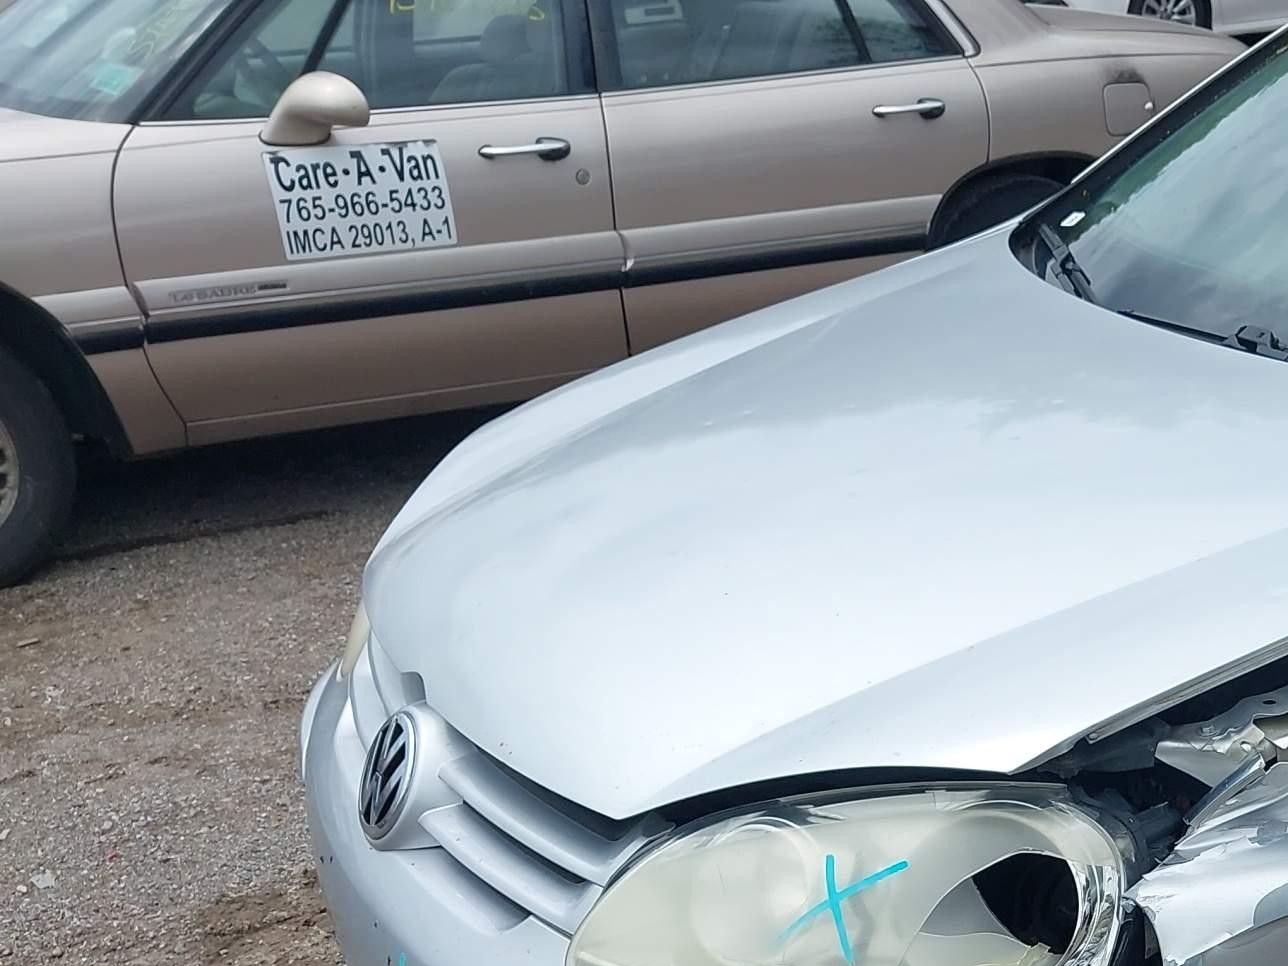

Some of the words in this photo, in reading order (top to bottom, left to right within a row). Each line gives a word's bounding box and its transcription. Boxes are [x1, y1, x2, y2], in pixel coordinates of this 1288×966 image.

[279, 185, 446, 224] 765-966-5433
[286, 226, 345, 255] IMCA
[348, 219, 417, 249] 29013,
[421, 215, 452, 242] A-1
